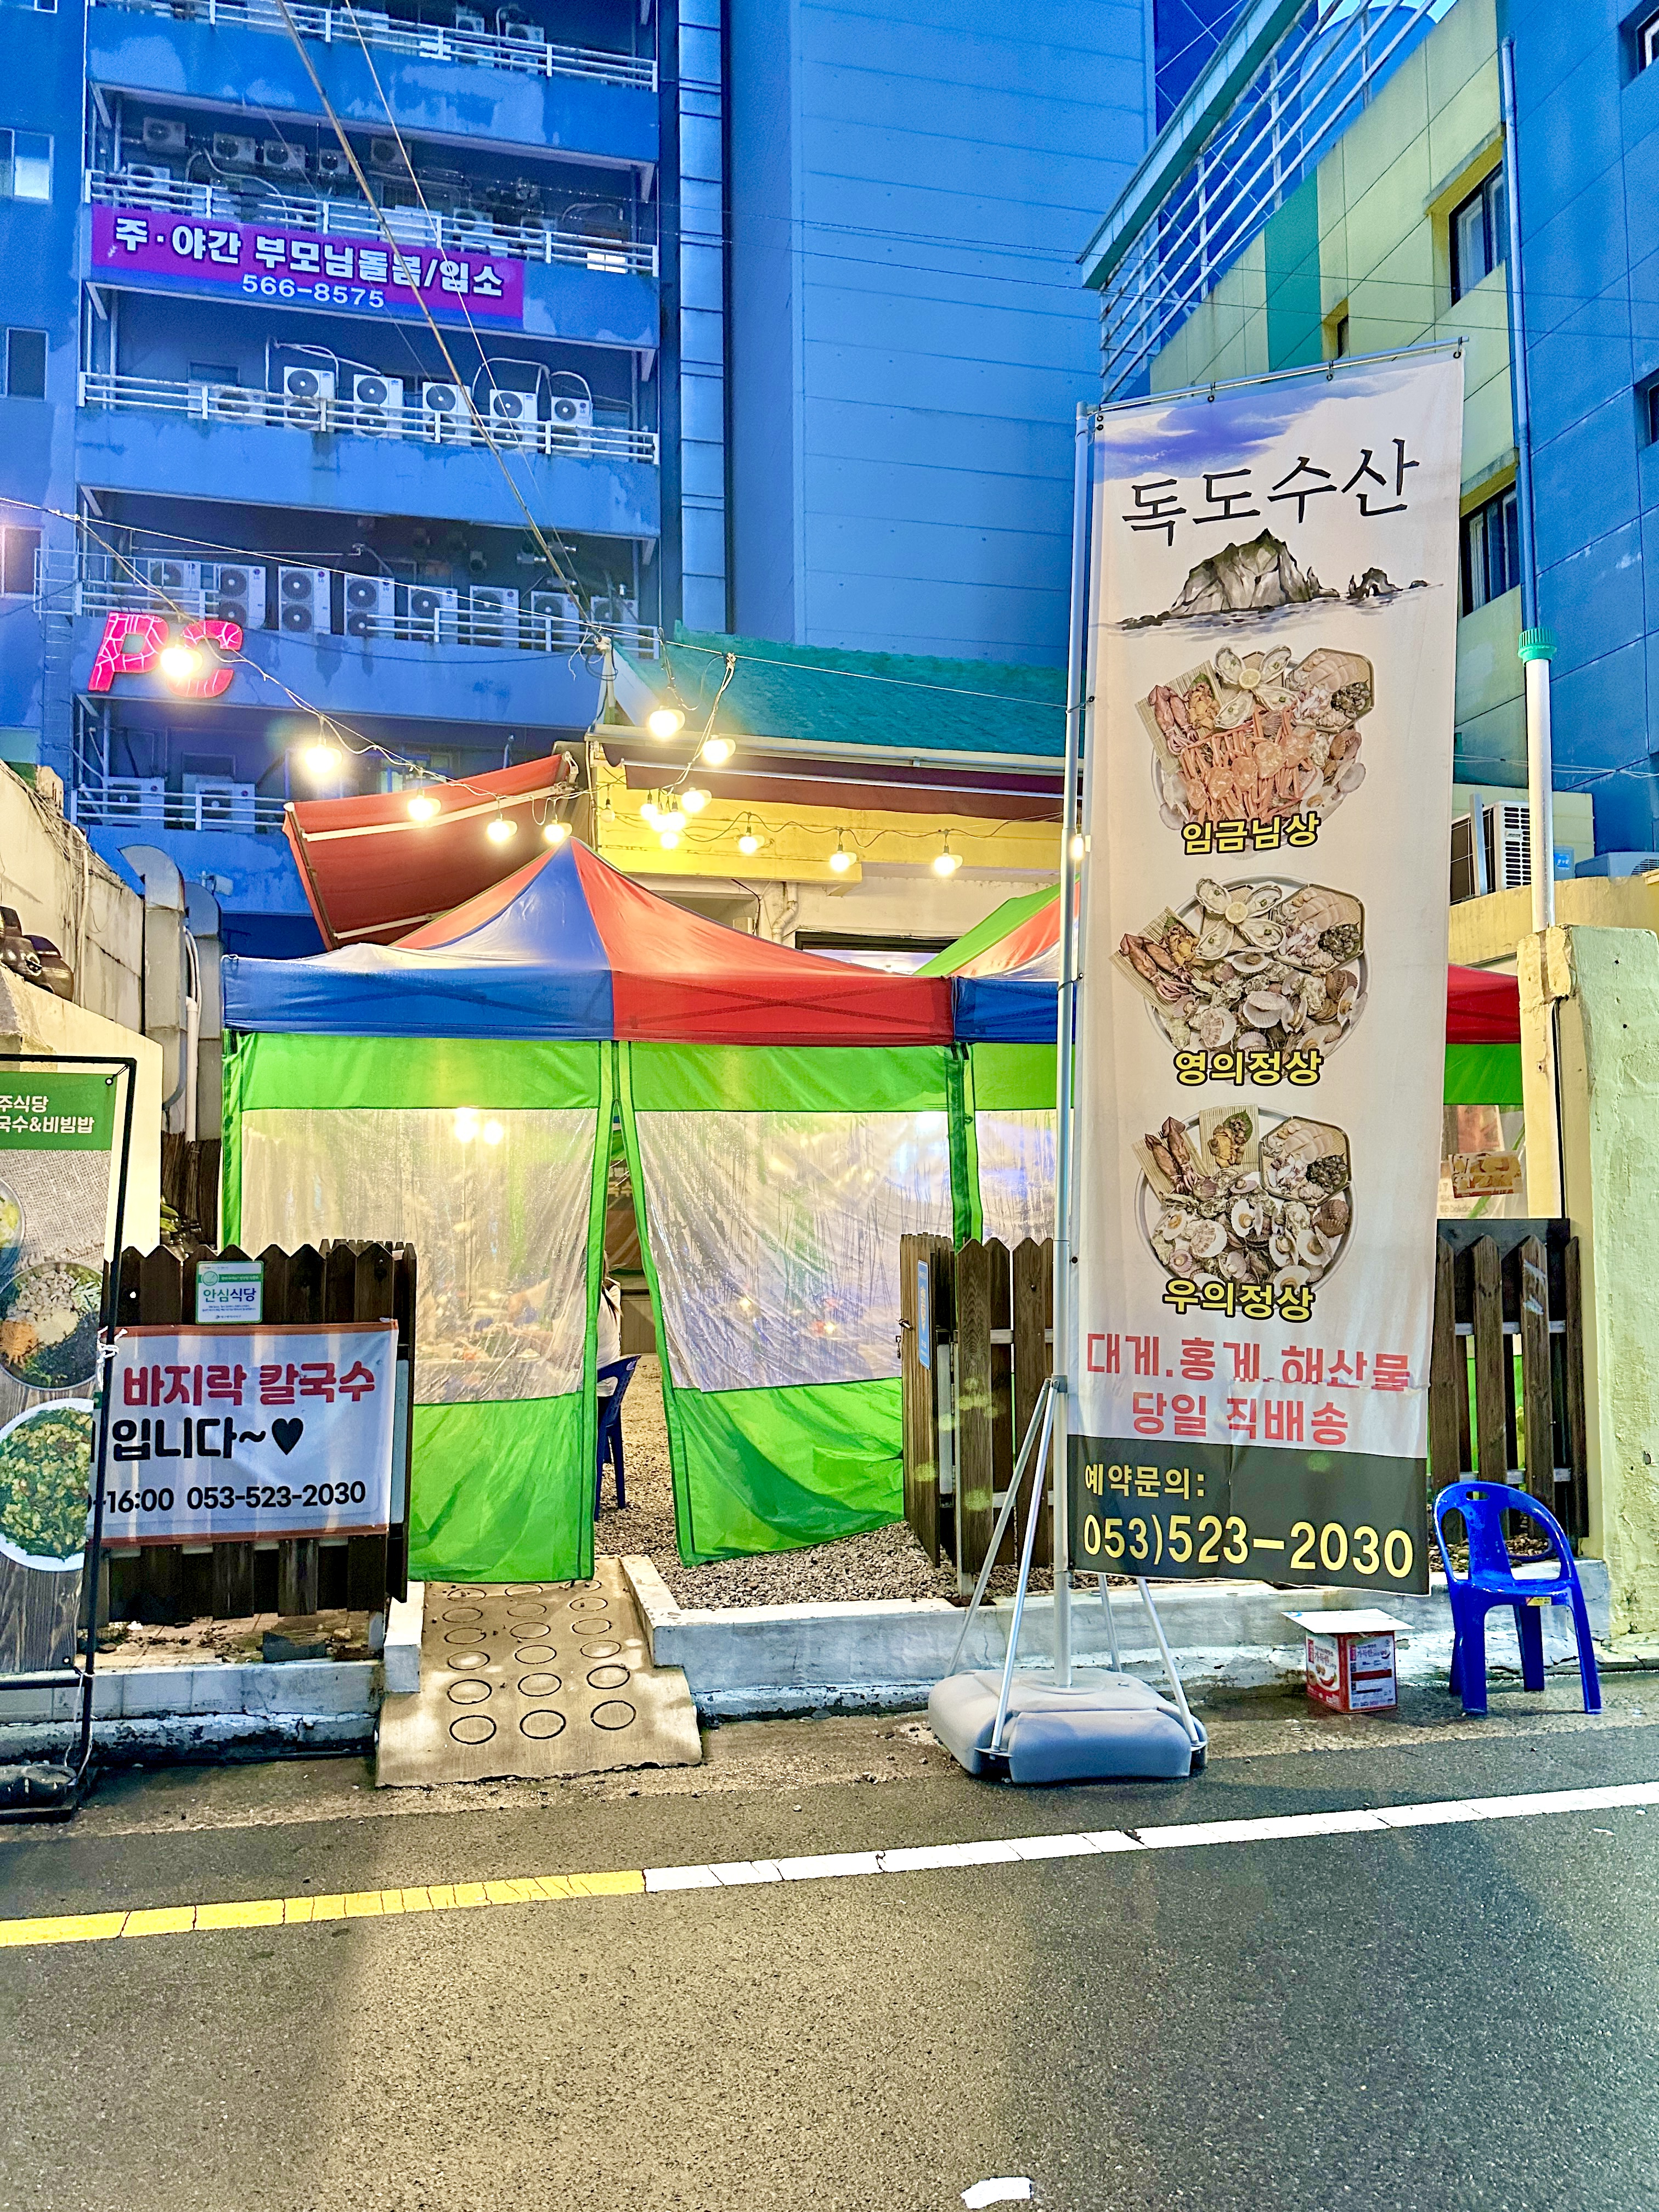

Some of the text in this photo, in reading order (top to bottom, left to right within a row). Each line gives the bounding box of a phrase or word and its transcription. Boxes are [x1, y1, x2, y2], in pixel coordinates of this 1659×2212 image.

[242, 273, 385, 308] 566-8575
[1122, 438, 1420, 546] 독도수산
[88, 612, 244, 698] PC
[1181, 811, 1321, 855] 임금님상
[1173, 1048, 1323, 1087] 영의정상
[204, 1288, 256, 1302] 안심식당
[1163, 1277, 1316, 1323] 우의정상
[123, 1361, 375, 1407] 바지락 칼국수
[1133, 1392, 1348, 1445] 당일 직배송
[187, 1481, 366, 1509] 053-523-2030
[1085, 1464, 1205, 1500] 예약문의:
[1083, 1514, 1413, 1578] 053)523-2030
